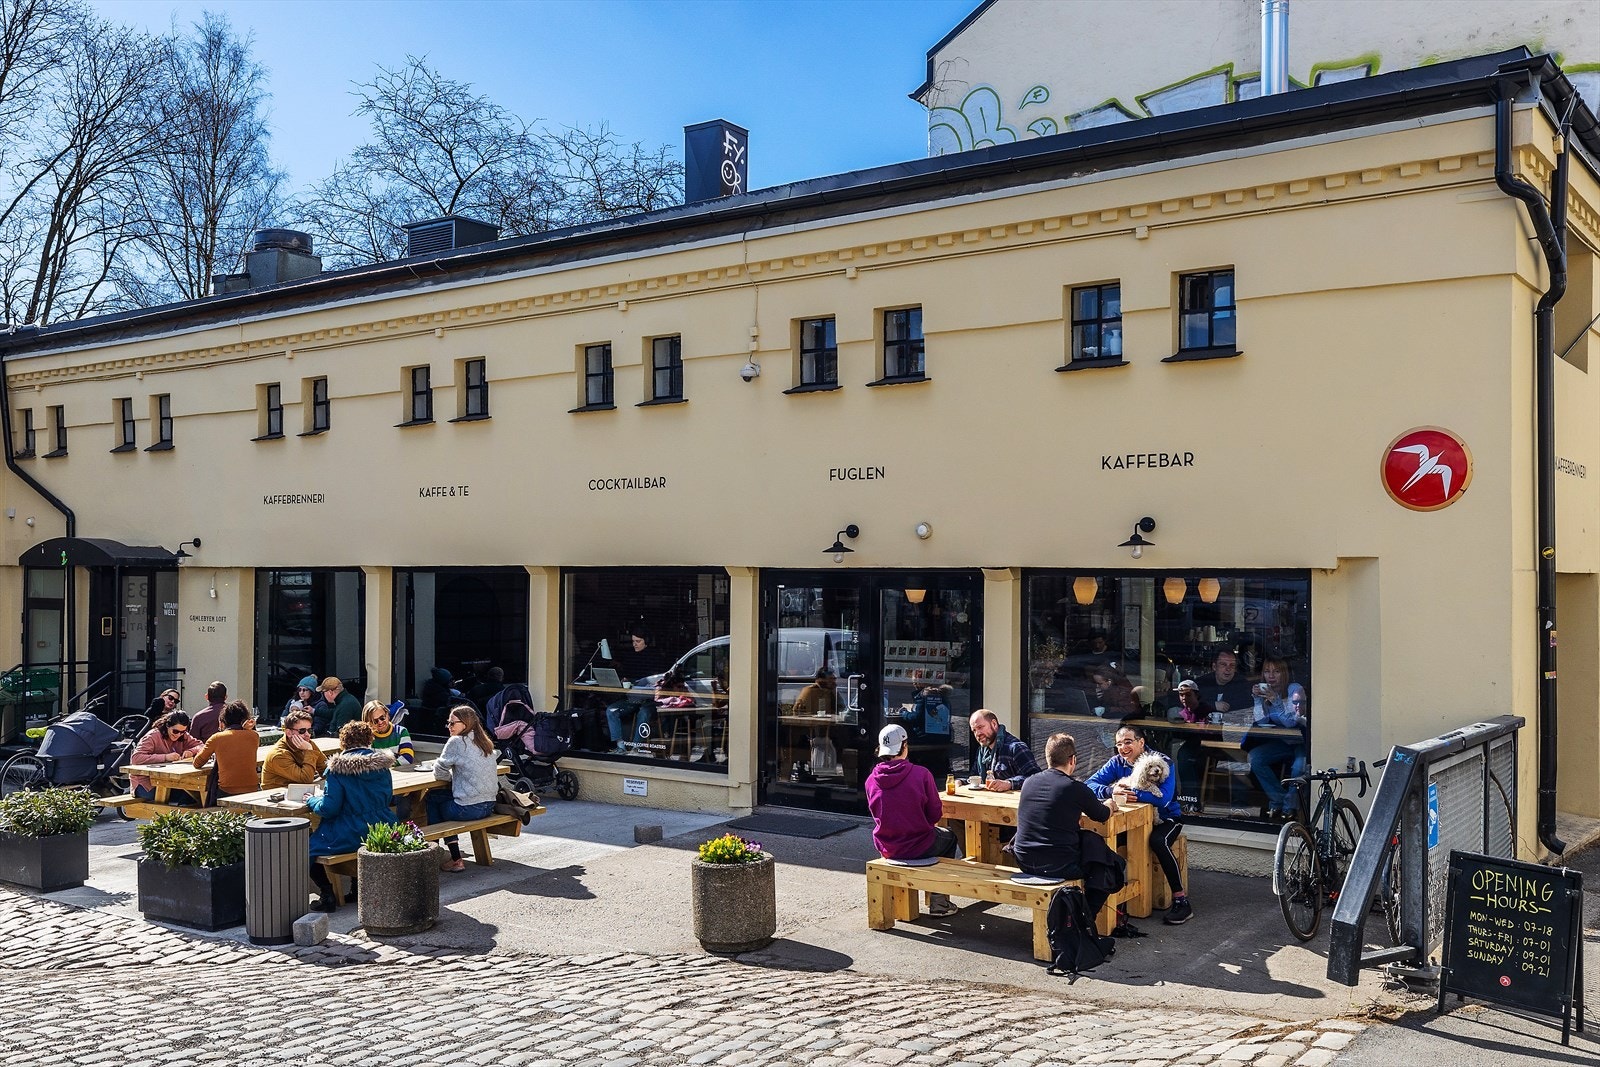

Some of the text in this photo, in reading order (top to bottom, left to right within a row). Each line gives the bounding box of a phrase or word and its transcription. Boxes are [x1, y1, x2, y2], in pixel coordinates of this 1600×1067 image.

[1101, 452, 1195, 470] KAFFEBAR
[829, 466, 885, 481] FUGLEN
[588, 476, 667, 491] COCKTAILBAR
[263, 493, 325, 505] KAFFEBRENNERI
[419, 485, 470, 498] KAFFE & TE
[1472, 870, 1554, 902] OPENING
[1523, 921, 1553, 937] 07-18
[1468, 937, 1515, 958] SATURDAY
[1522, 951, 1551, 966] 09-01
[1522, 937, 1551, 952] 07-01
[1467, 949, 1505, 965] SUNDAY
